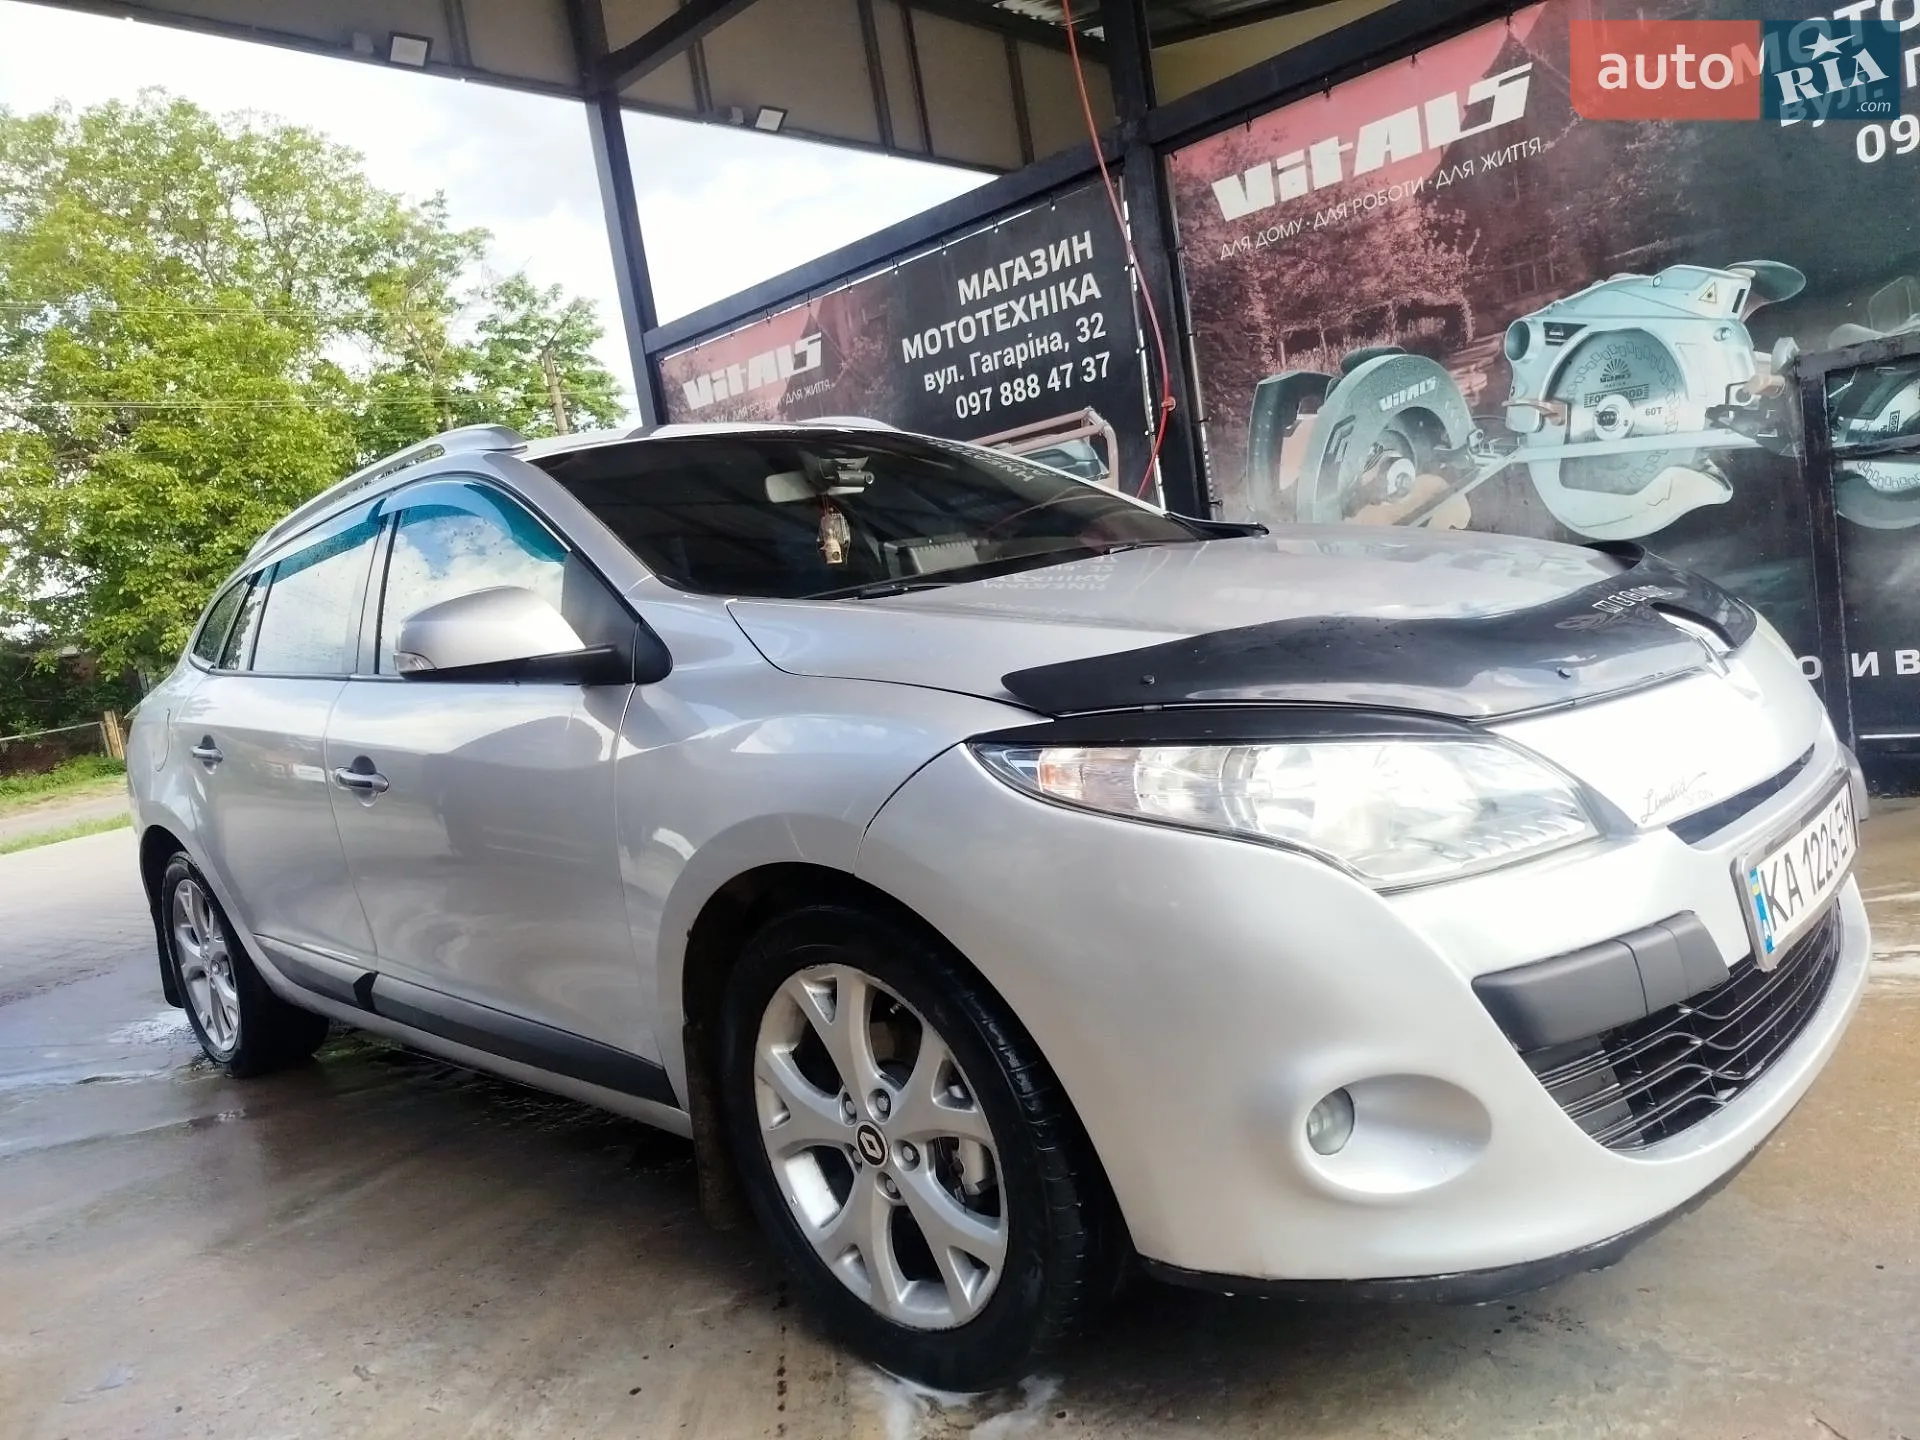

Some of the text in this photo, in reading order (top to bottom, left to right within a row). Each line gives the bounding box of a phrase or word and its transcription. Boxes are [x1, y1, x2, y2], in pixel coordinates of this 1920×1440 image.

[1220, 136, 1542, 261] ДЛЯ ДОМУ ДЛЯ РОБОТИ ДЛЯ ЖИТТЯ
[957, 230, 1094, 306] МАГАЗИН
[901, 272, 1102, 364] МОТОТЕХНІКА
[923, 312, 1107, 394] вул. Гагаріна, 32
[955, 351, 1111, 419] 097 888 47 37
[1761, 852, 1804, 932] KA
[1803, 813, 1840, 896] 1226
